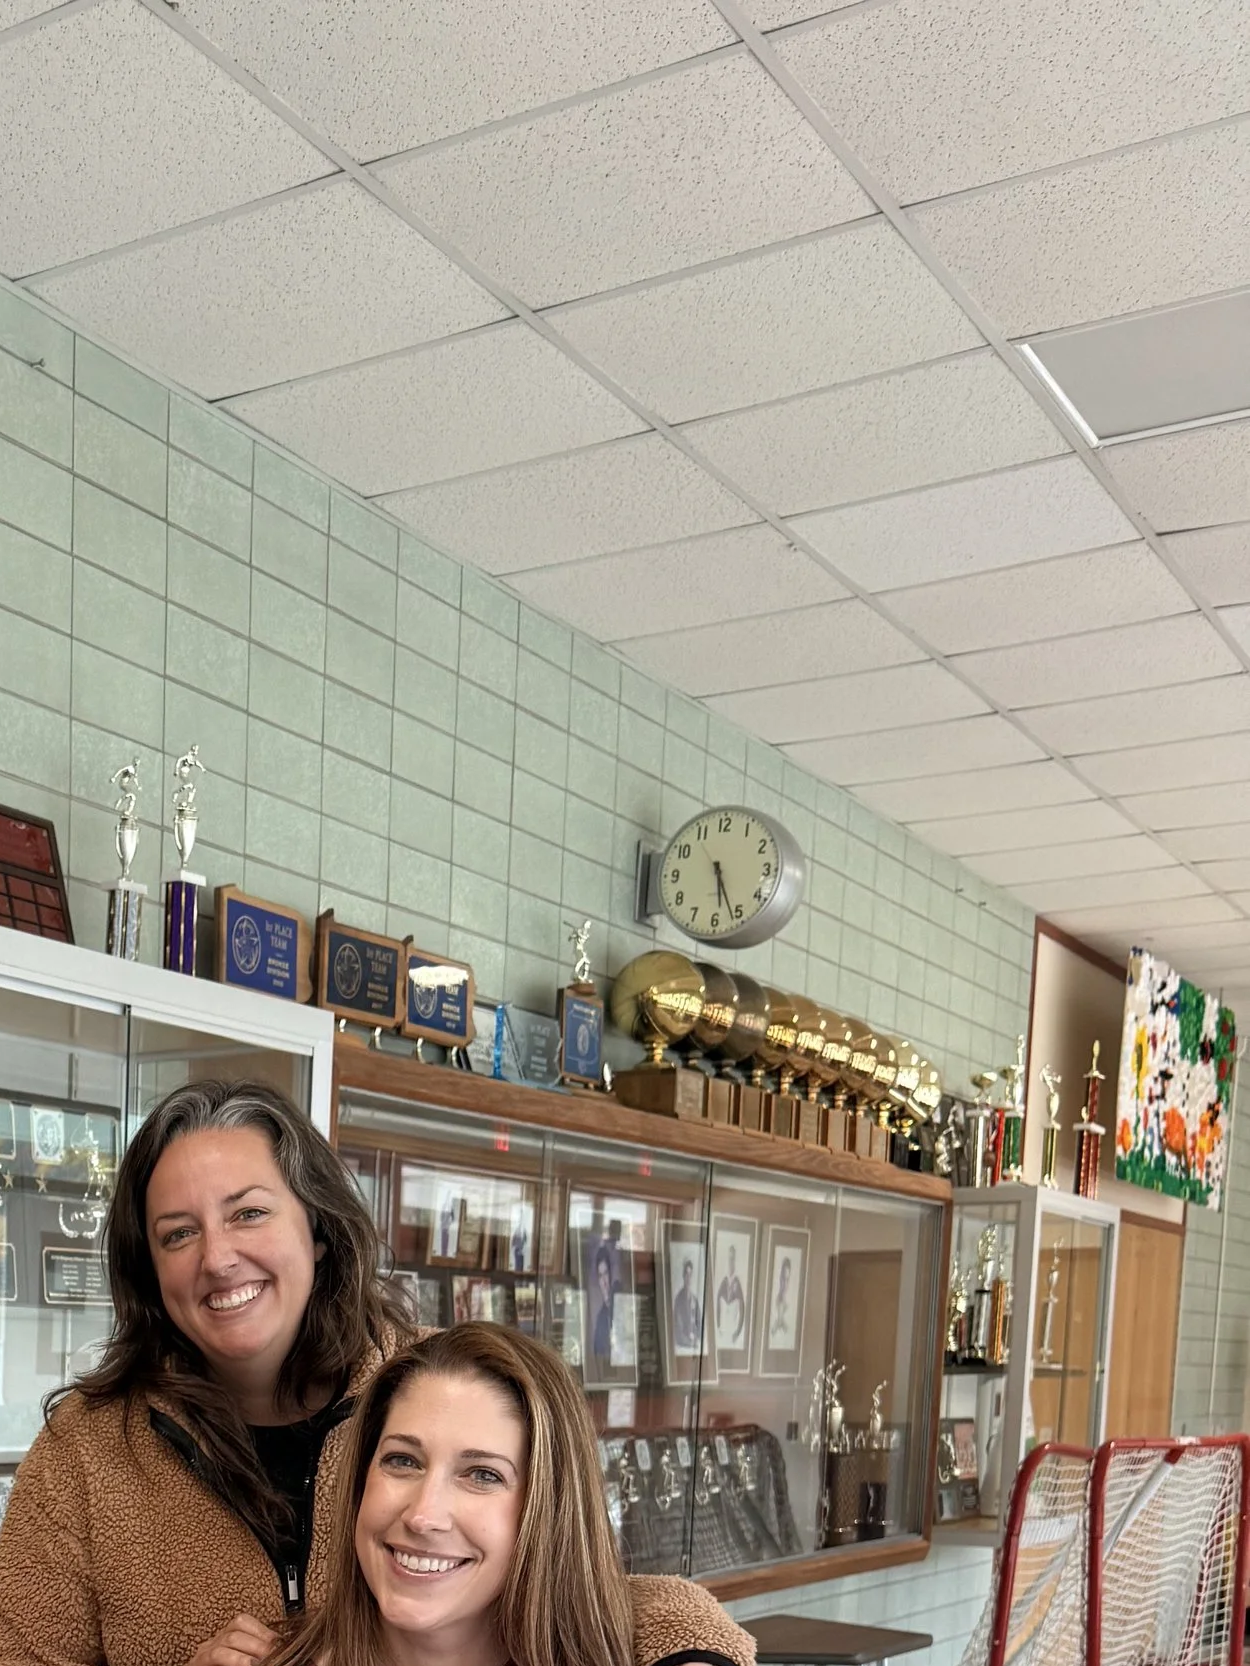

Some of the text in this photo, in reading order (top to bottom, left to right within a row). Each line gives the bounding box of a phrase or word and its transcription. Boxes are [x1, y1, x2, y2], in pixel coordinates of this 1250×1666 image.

[697, 825, 708, 840] 11
[718, 818, 732, 832] 12
[678, 844, 690, 858] 10
[758, 839, 767, 854] 2
[671, 869, 680, 883] 9
[762, 862, 771, 876] 3
[675, 891, 684, 906] 8
[753, 887, 762, 902] 4
[690, 907, 698, 922] 7
[735, 904, 744, 918] 5
[710, 913, 719, 928] 6
[274, 922, 292, 939] PLACE
[270, 936, 288, 950] TEAM
